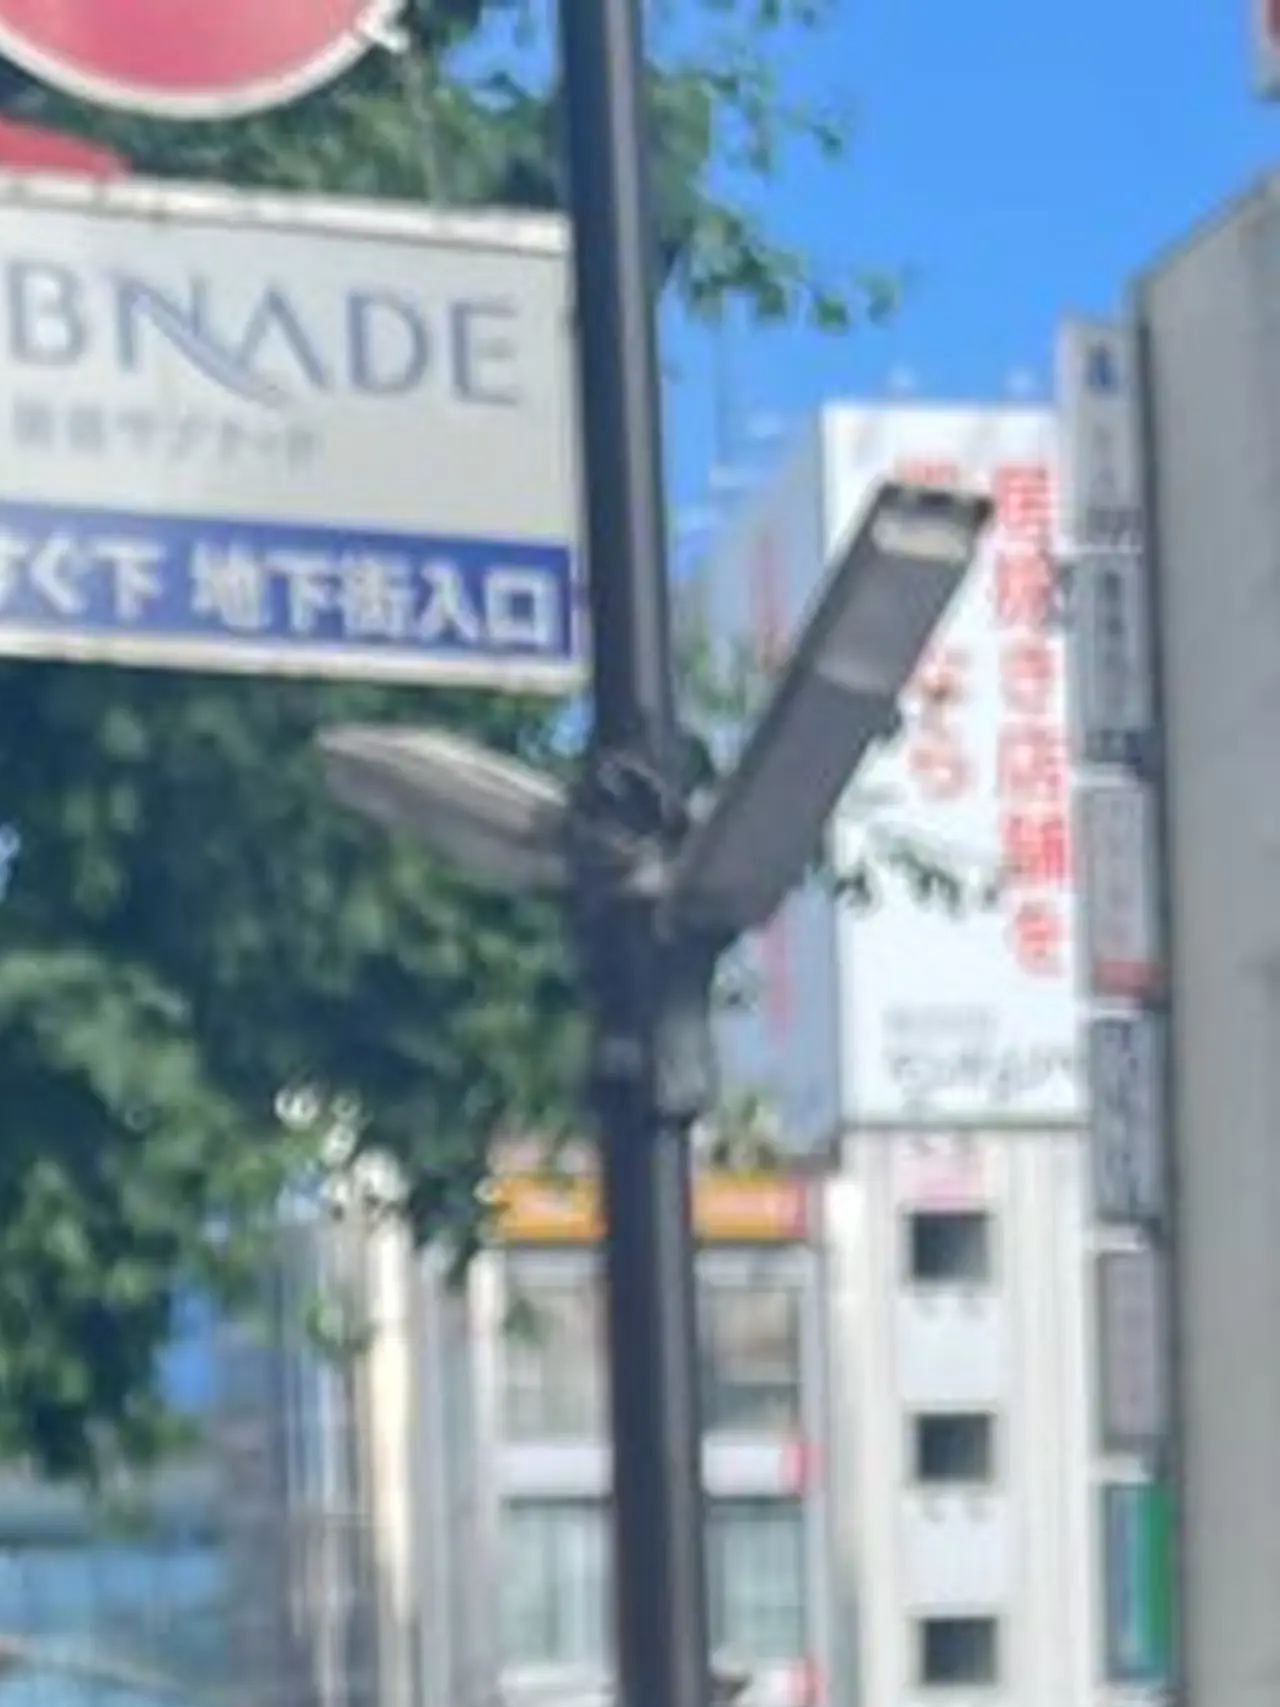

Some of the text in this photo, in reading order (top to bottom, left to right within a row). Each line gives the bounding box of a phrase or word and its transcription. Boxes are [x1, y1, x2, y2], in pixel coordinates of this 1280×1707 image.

[188, 538, 559, 646] 地下街入口
